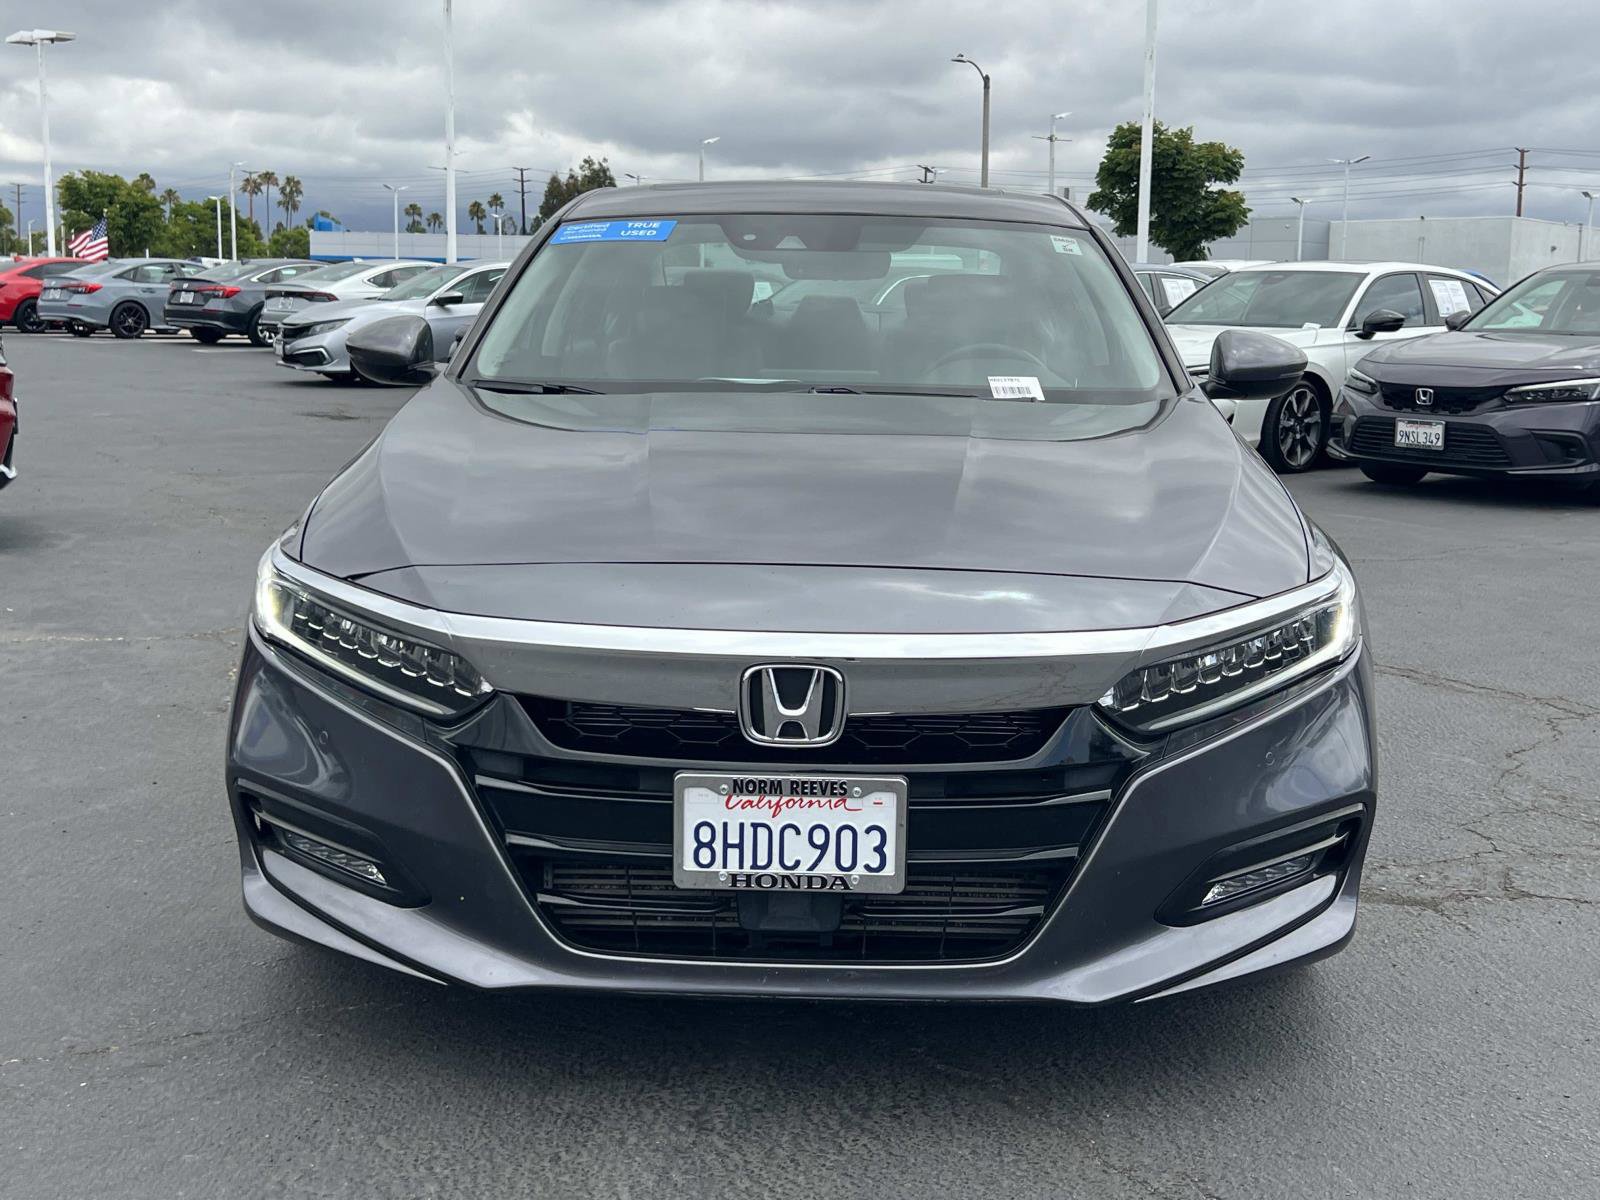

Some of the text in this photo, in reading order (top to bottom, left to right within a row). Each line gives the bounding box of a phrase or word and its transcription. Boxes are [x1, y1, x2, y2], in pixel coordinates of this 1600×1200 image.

[620, 229, 657, 237] USED
[626, 221, 661, 229] TRUE
[1398, 430, 1441, 445] 9NSL349
[732, 778, 848, 796] NORM REEVES
[725, 794, 863, 818] California
[693, 820, 887, 873] 8HDC903
[728, 873, 854, 890] HONDA
